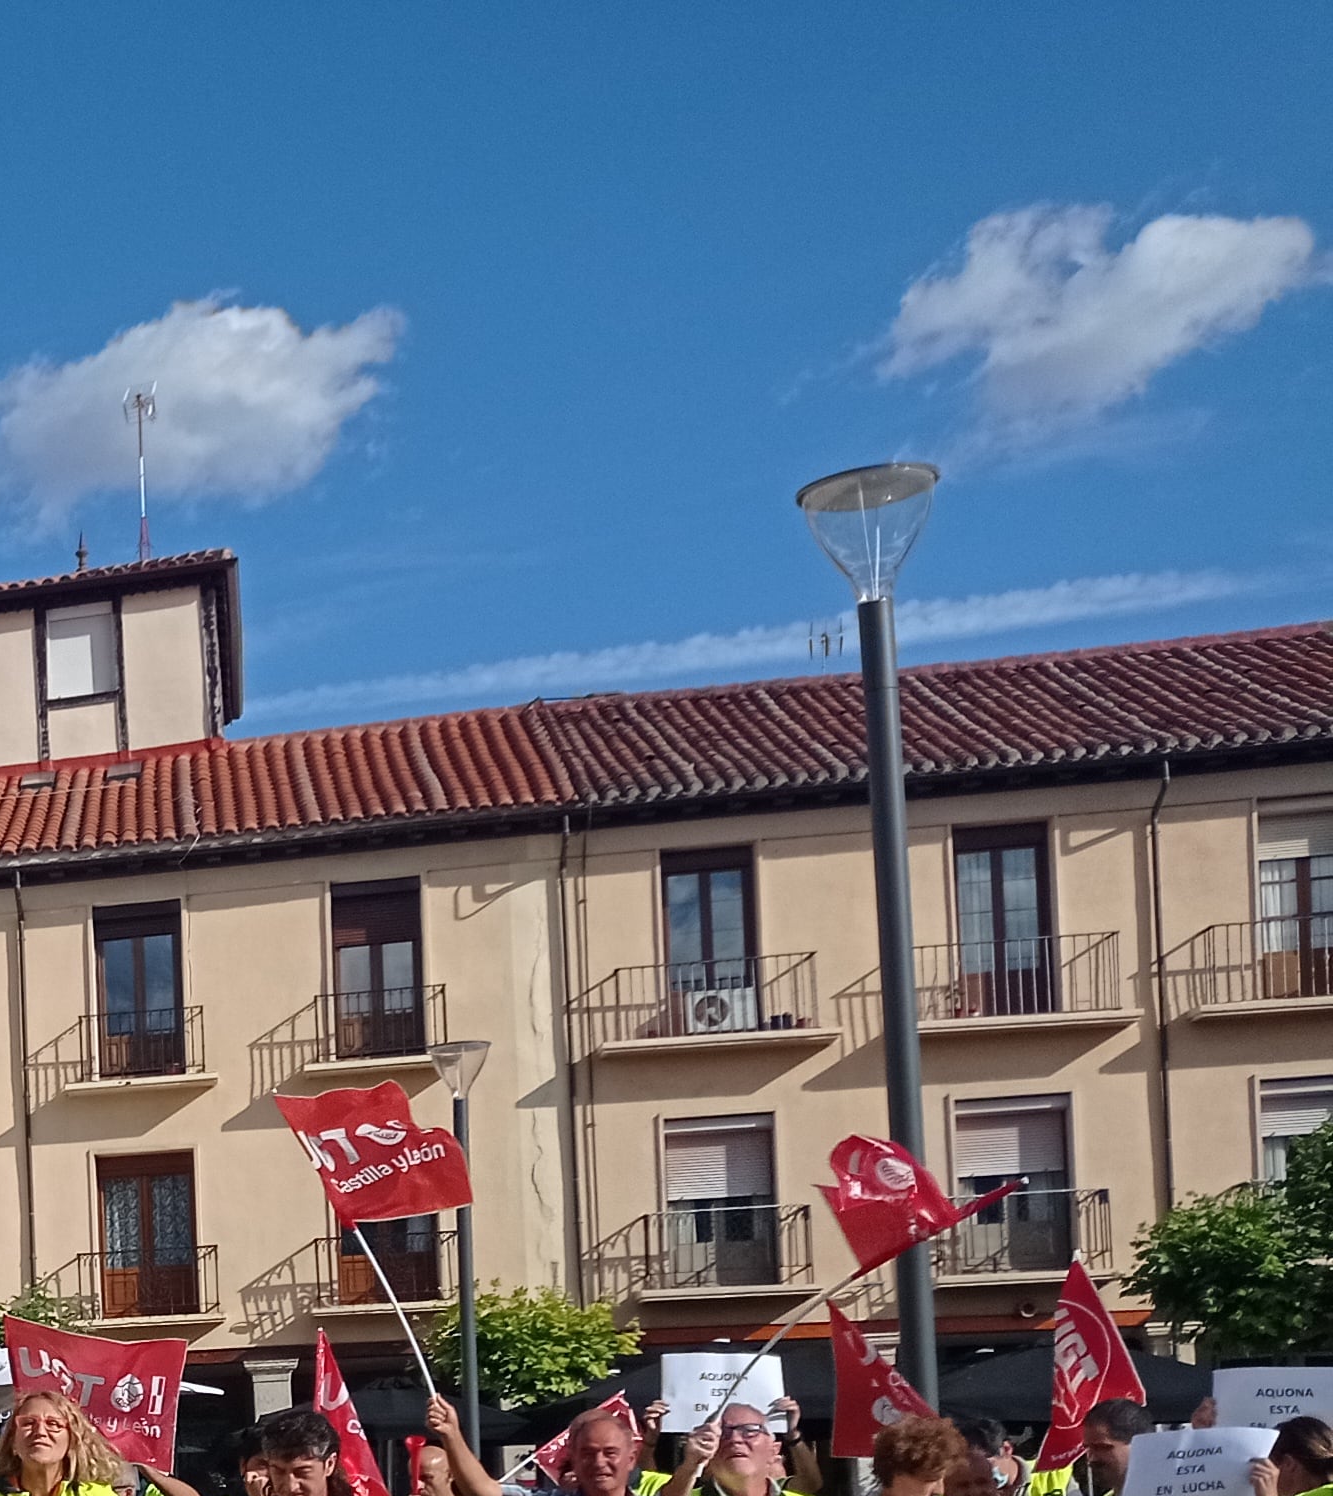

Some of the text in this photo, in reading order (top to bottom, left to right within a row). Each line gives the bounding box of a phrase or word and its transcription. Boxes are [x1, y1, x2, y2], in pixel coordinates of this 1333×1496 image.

[1255, 1387, 1314, 1398] AQUONA
[695, 1403, 710, 1412] EN
[1269, 1404, 1301, 1415] ESTA
[107, 1416, 119, 1433] y
[1166, 1446, 1223, 1459] AQUONA
[1176, 1464, 1206, 1475] ESTA
[1156, 1480, 1225, 1496] EN LUCHA
